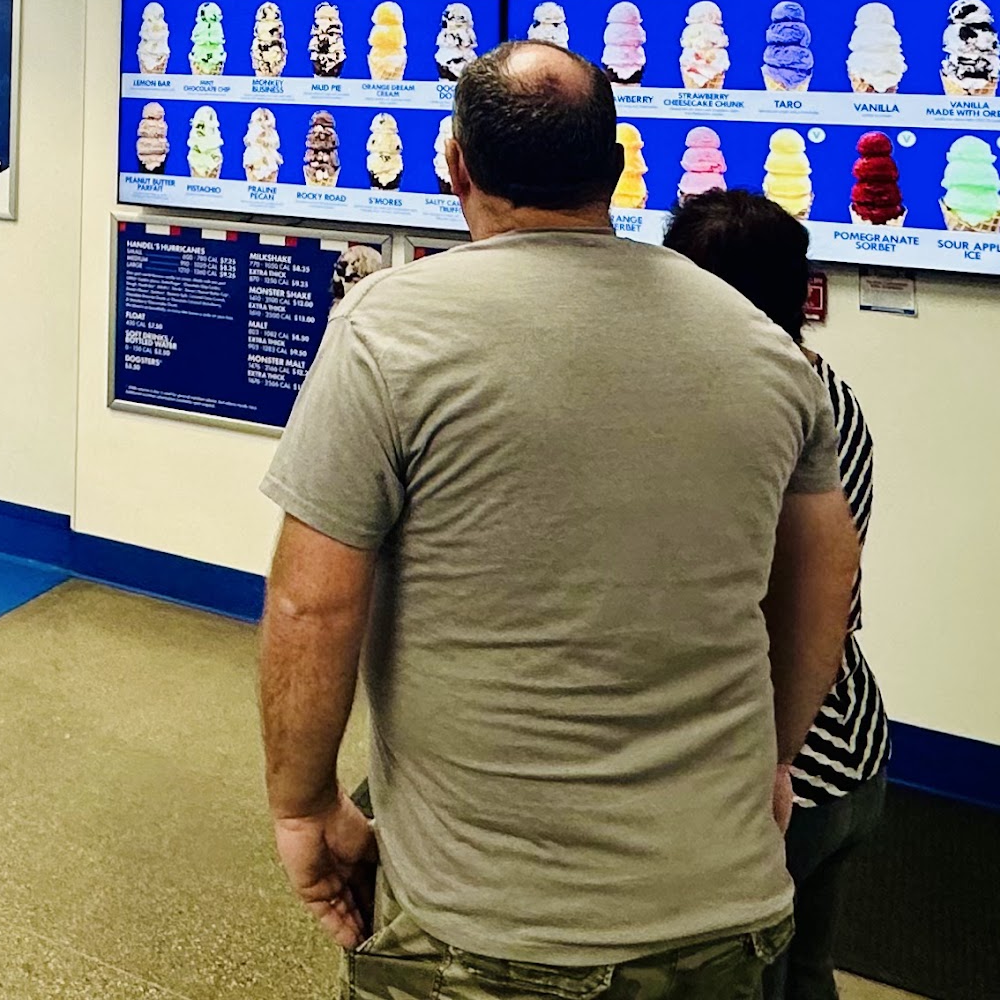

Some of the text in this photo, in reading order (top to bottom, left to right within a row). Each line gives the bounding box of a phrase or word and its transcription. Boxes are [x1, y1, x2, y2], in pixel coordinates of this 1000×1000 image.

[252, 79, 284, 87] MONKEY
[331, 84, 342, 92] PIE
[614, 96, 654, 104] WBERRY
[678, 92, 729, 100] STRAWBERRY
[664, 99, 744, 108] CHEESECAKE CHUNK
[774, 100, 802, 109] TARO
[854, 103, 899, 112] VANILLA
[950, 101, 989, 109] VANILLA
[926, 108, 1000, 118] MADE WITH ORE
[137, 184, 163, 192] PARFAIT
[187, 185, 221, 194] PISTACHIO
[248, 186, 277, 194] PRALINE
[296, 192, 347, 202] ROCKY ROAD
[368, 197, 402, 206] S'MORES
[425, 198, 445, 206] SALTY
[834, 231, 919, 245] POMEGRANATE
[126, 240, 205, 255] HANDEL'S HURRICANES
[856, 242, 896, 252] SORBET
[937, 240, 1000, 252] SOUR APPL
[249, 253, 292, 264] MILKSHAKE
[965, 251, 981, 260] ICE
[269, 270, 286, 278] THICK
[249, 286, 311, 300] MONSTER SHAKE
[248, 302, 286, 312] EXTRA THICK
[126, 311, 146, 320] FLOAT
[248, 320, 268, 329] MALT
[248, 336, 285, 347] EXTRA THICK
[248, 354, 305, 369] MONSTER MALT
[248, 370, 285, 380] EXTRA THICK
